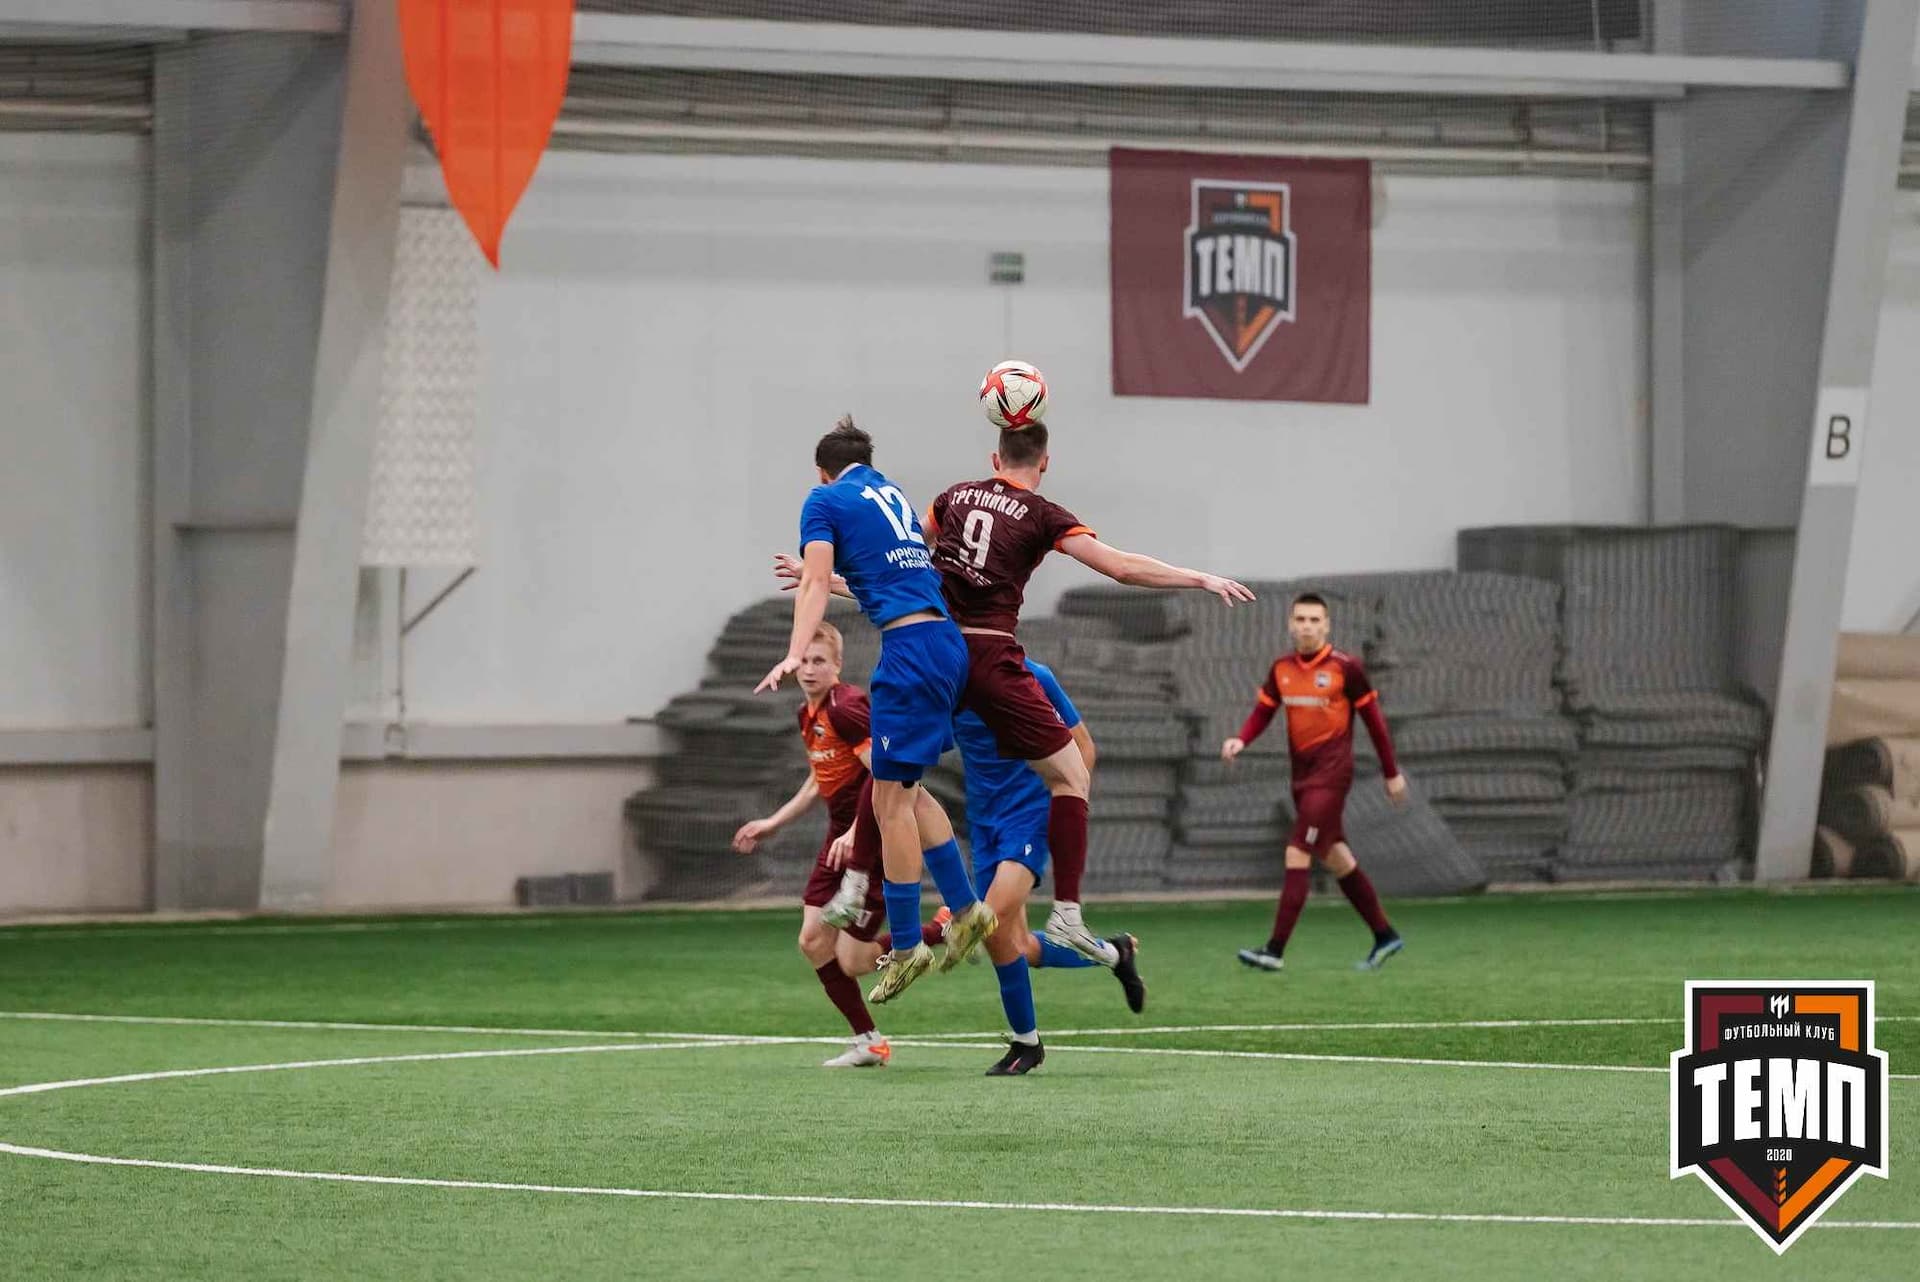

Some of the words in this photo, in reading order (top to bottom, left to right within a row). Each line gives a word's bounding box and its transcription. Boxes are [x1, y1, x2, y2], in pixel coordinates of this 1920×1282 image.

[1195, 234, 1285, 301] ТЕМП
[860, 485, 925, 545] 12
[951, 488, 1029, 521] ГРЕЧНИКОВ
[959, 509, 993, 569] 9
